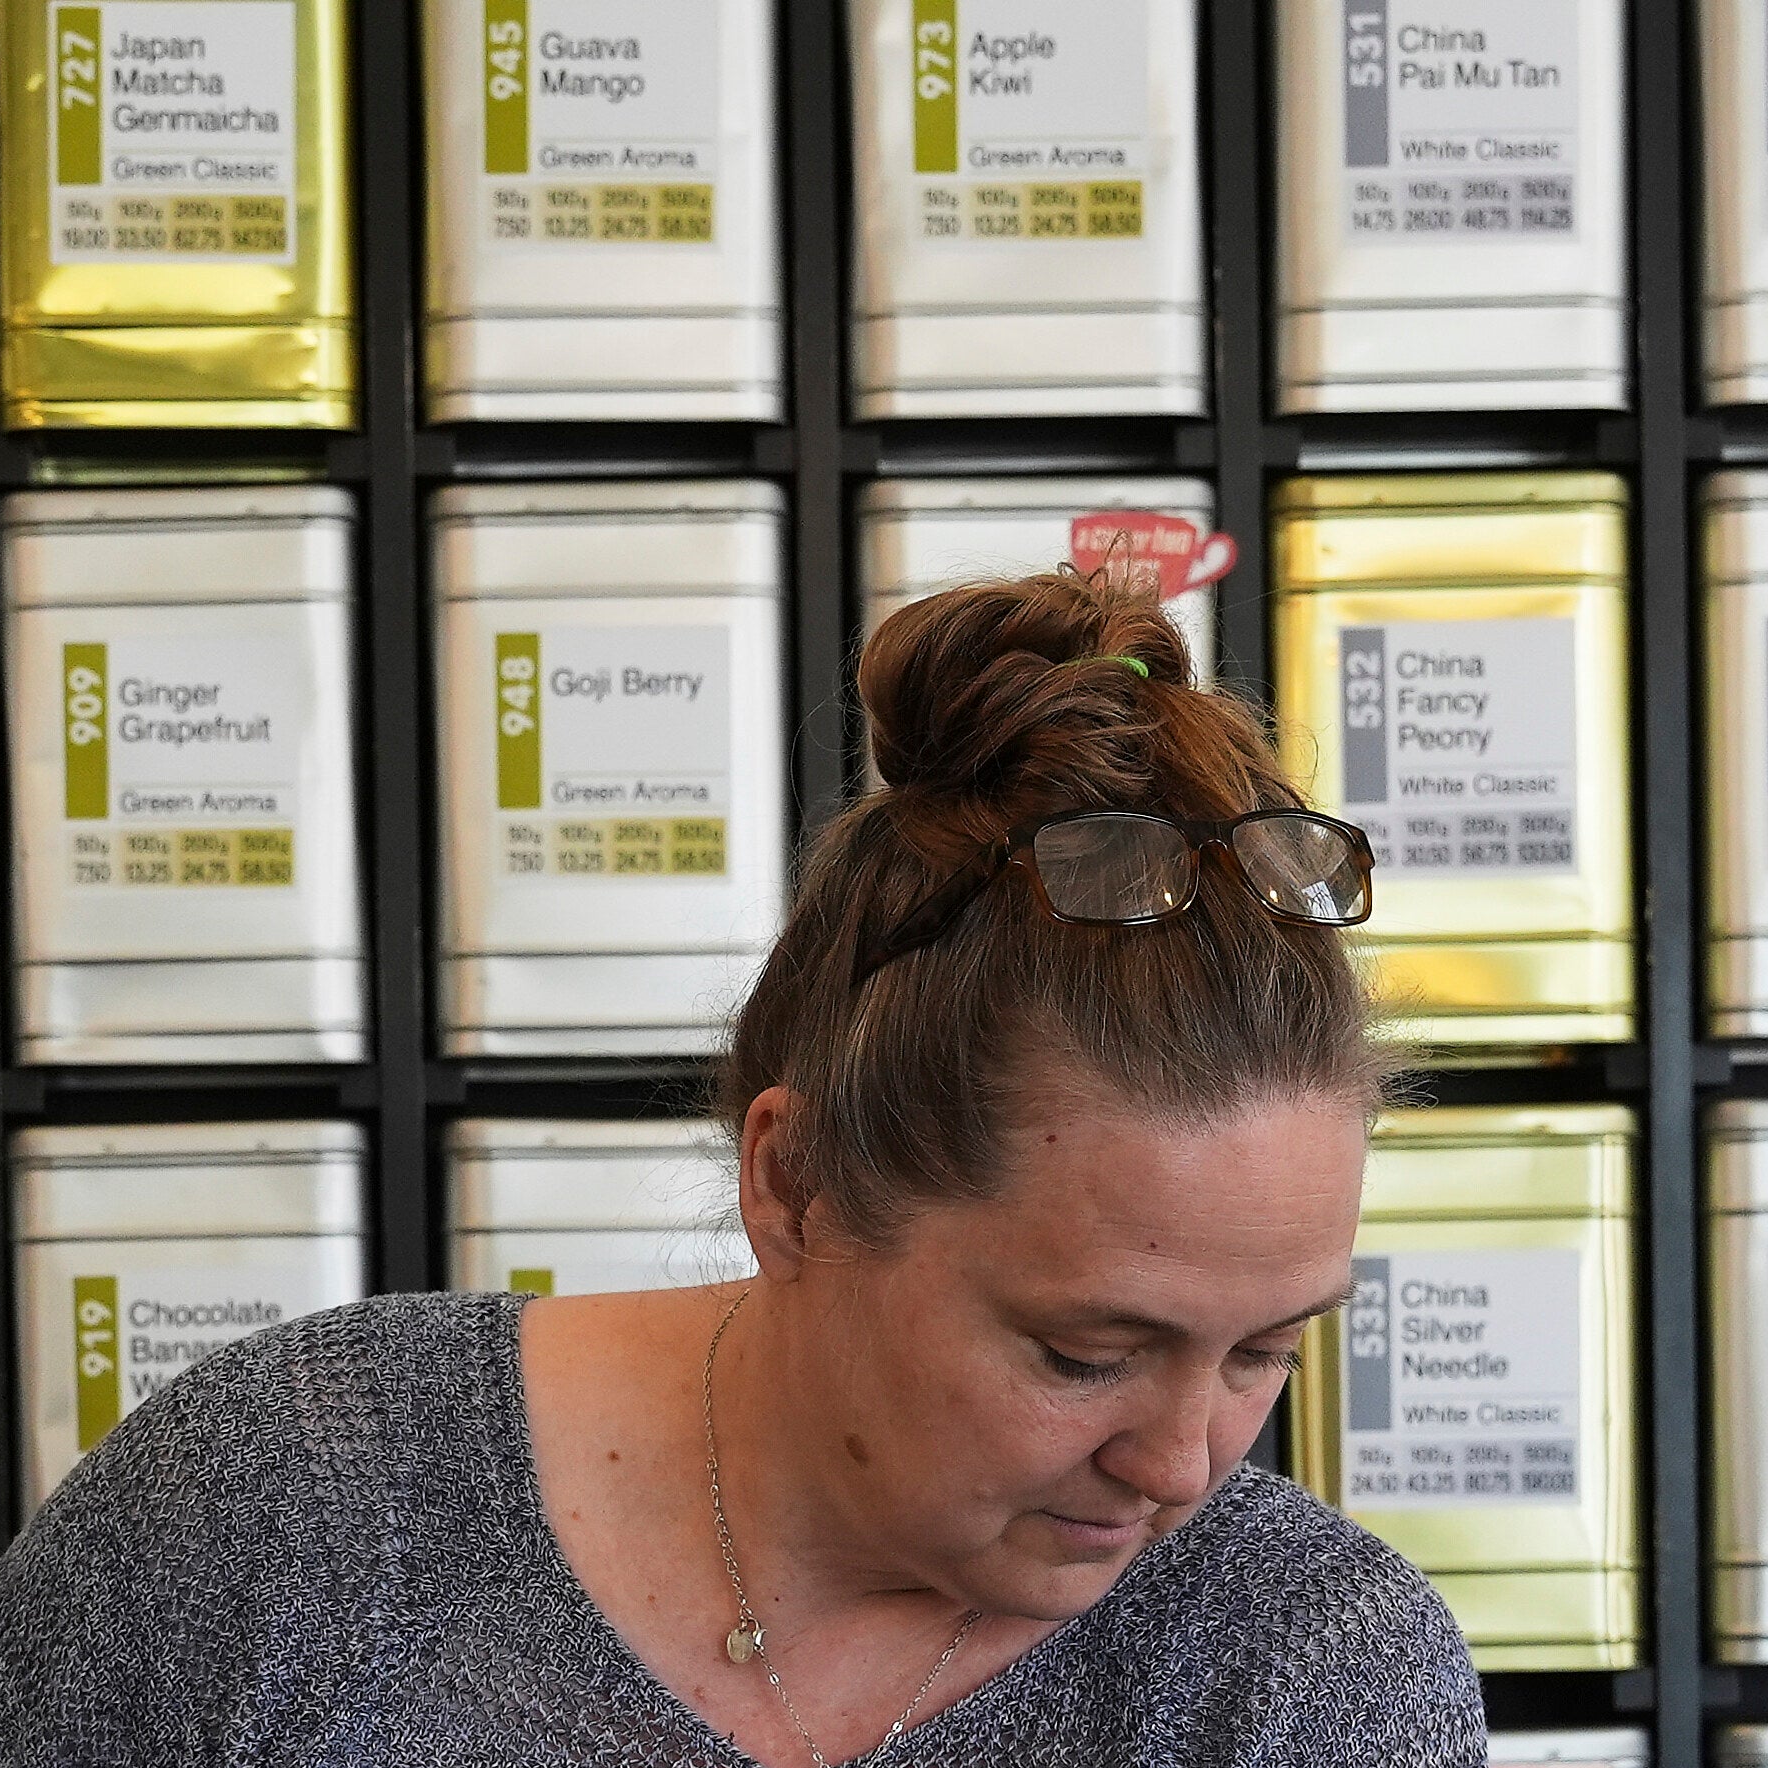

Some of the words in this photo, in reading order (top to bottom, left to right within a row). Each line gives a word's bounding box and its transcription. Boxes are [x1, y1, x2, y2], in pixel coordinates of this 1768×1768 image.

[110, 34, 205, 65] Japan
[539, 31, 641, 61] Guava
[969, 31, 1057, 64] Apple
[1349, 12, 1385, 87] 531
[1397, 24, 1486, 54] China
[489, 20, 523, 101] 945
[1398, 61, 1445, 89] Pai
[1454, 61, 1500, 88] Mu
[1507, 60, 1560, 88] Tan
[112, 68, 225, 97] Matcha
[540, 68, 645, 103] Mango
[969, 68, 1033, 97] Kiwi
[111, 103, 279, 133] Genmaicha
[1395, 649, 1486, 680] China
[118, 678, 221, 714] Ginger
[550, 667, 612, 703] Goji
[622, 667, 703, 701] Berry
[69, 666, 103, 745] 909
[1397, 687, 1490, 720] Fancy
[118, 714, 270, 748] Grapefruit
[1398, 722, 1492, 756] Peony
[1400, 1280, 1490, 1309] China
[129, 1297, 281, 1327] Chocolate
[79, 1299, 115, 1378] 919
[1401, 1315, 1486, 1345] Silver
[1402, 1352, 1509, 1380] Needle
